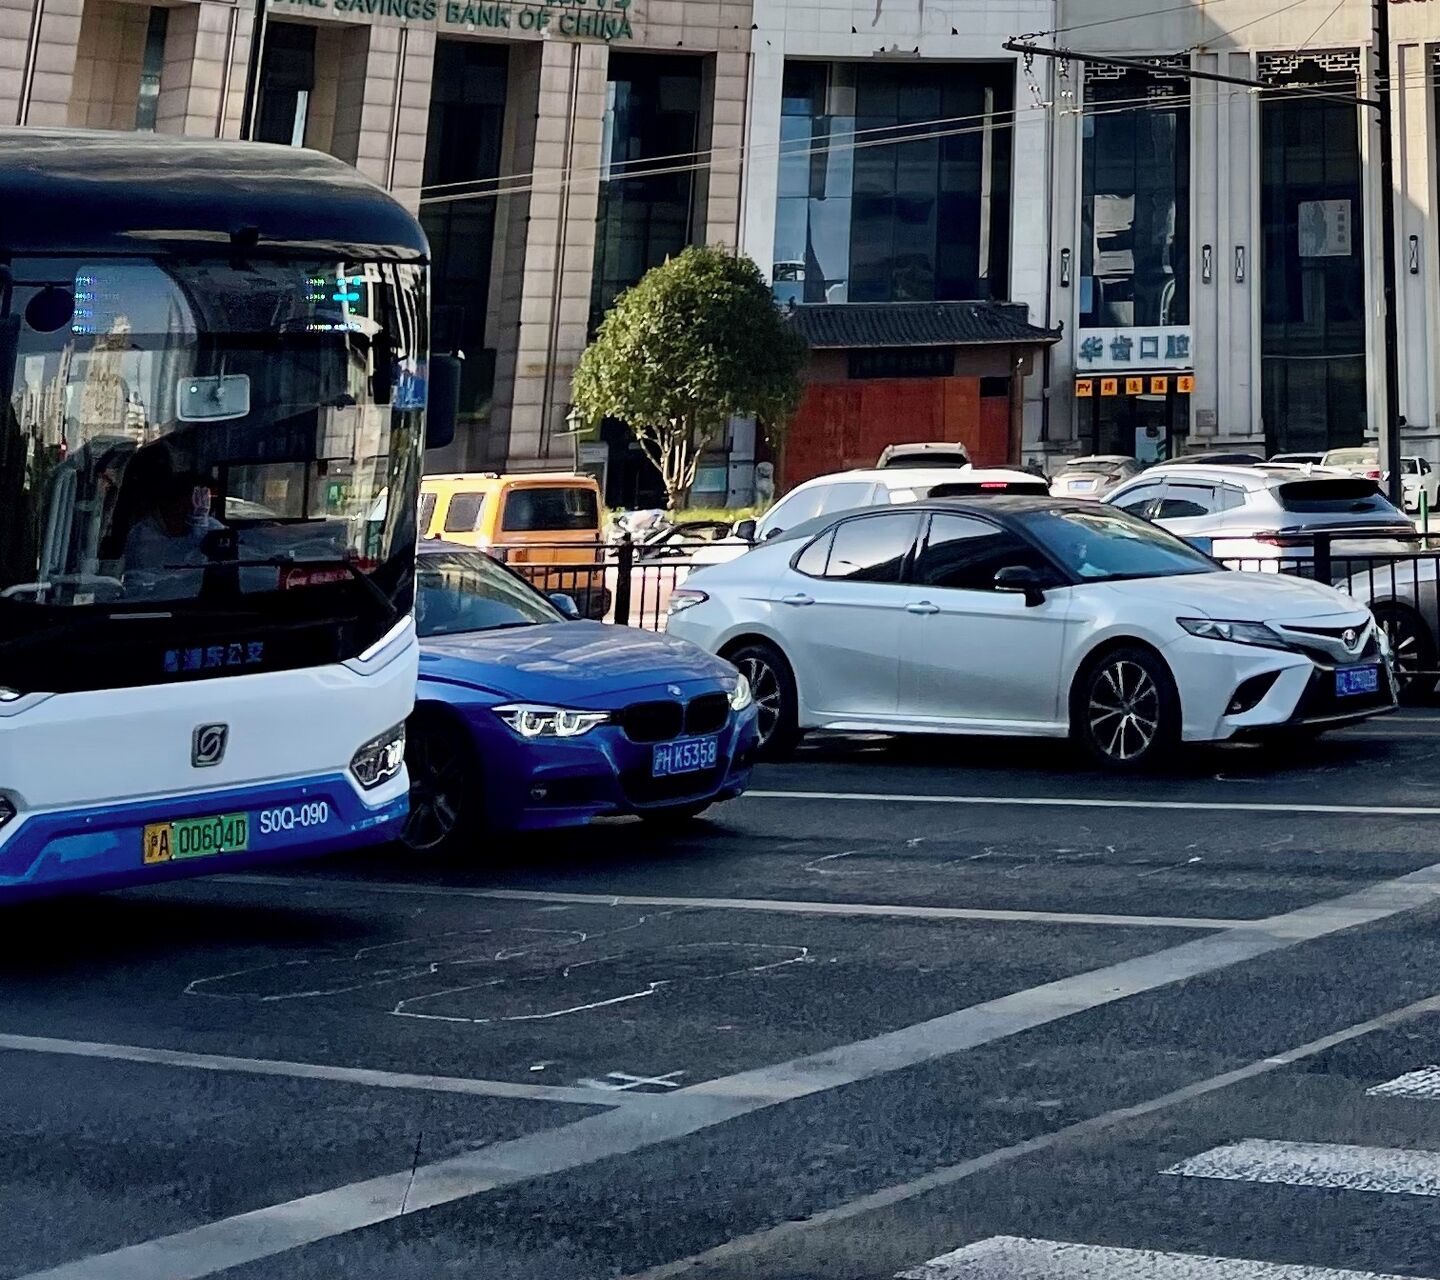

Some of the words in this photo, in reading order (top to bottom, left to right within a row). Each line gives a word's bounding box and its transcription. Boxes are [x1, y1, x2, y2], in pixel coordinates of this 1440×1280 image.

[519, 7, 551, 32] OF
[559, 8, 635, 40] CHINA
[1079, 334, 1190, 363] 华齿口腔
[674, 741, 716, 768] K5358
